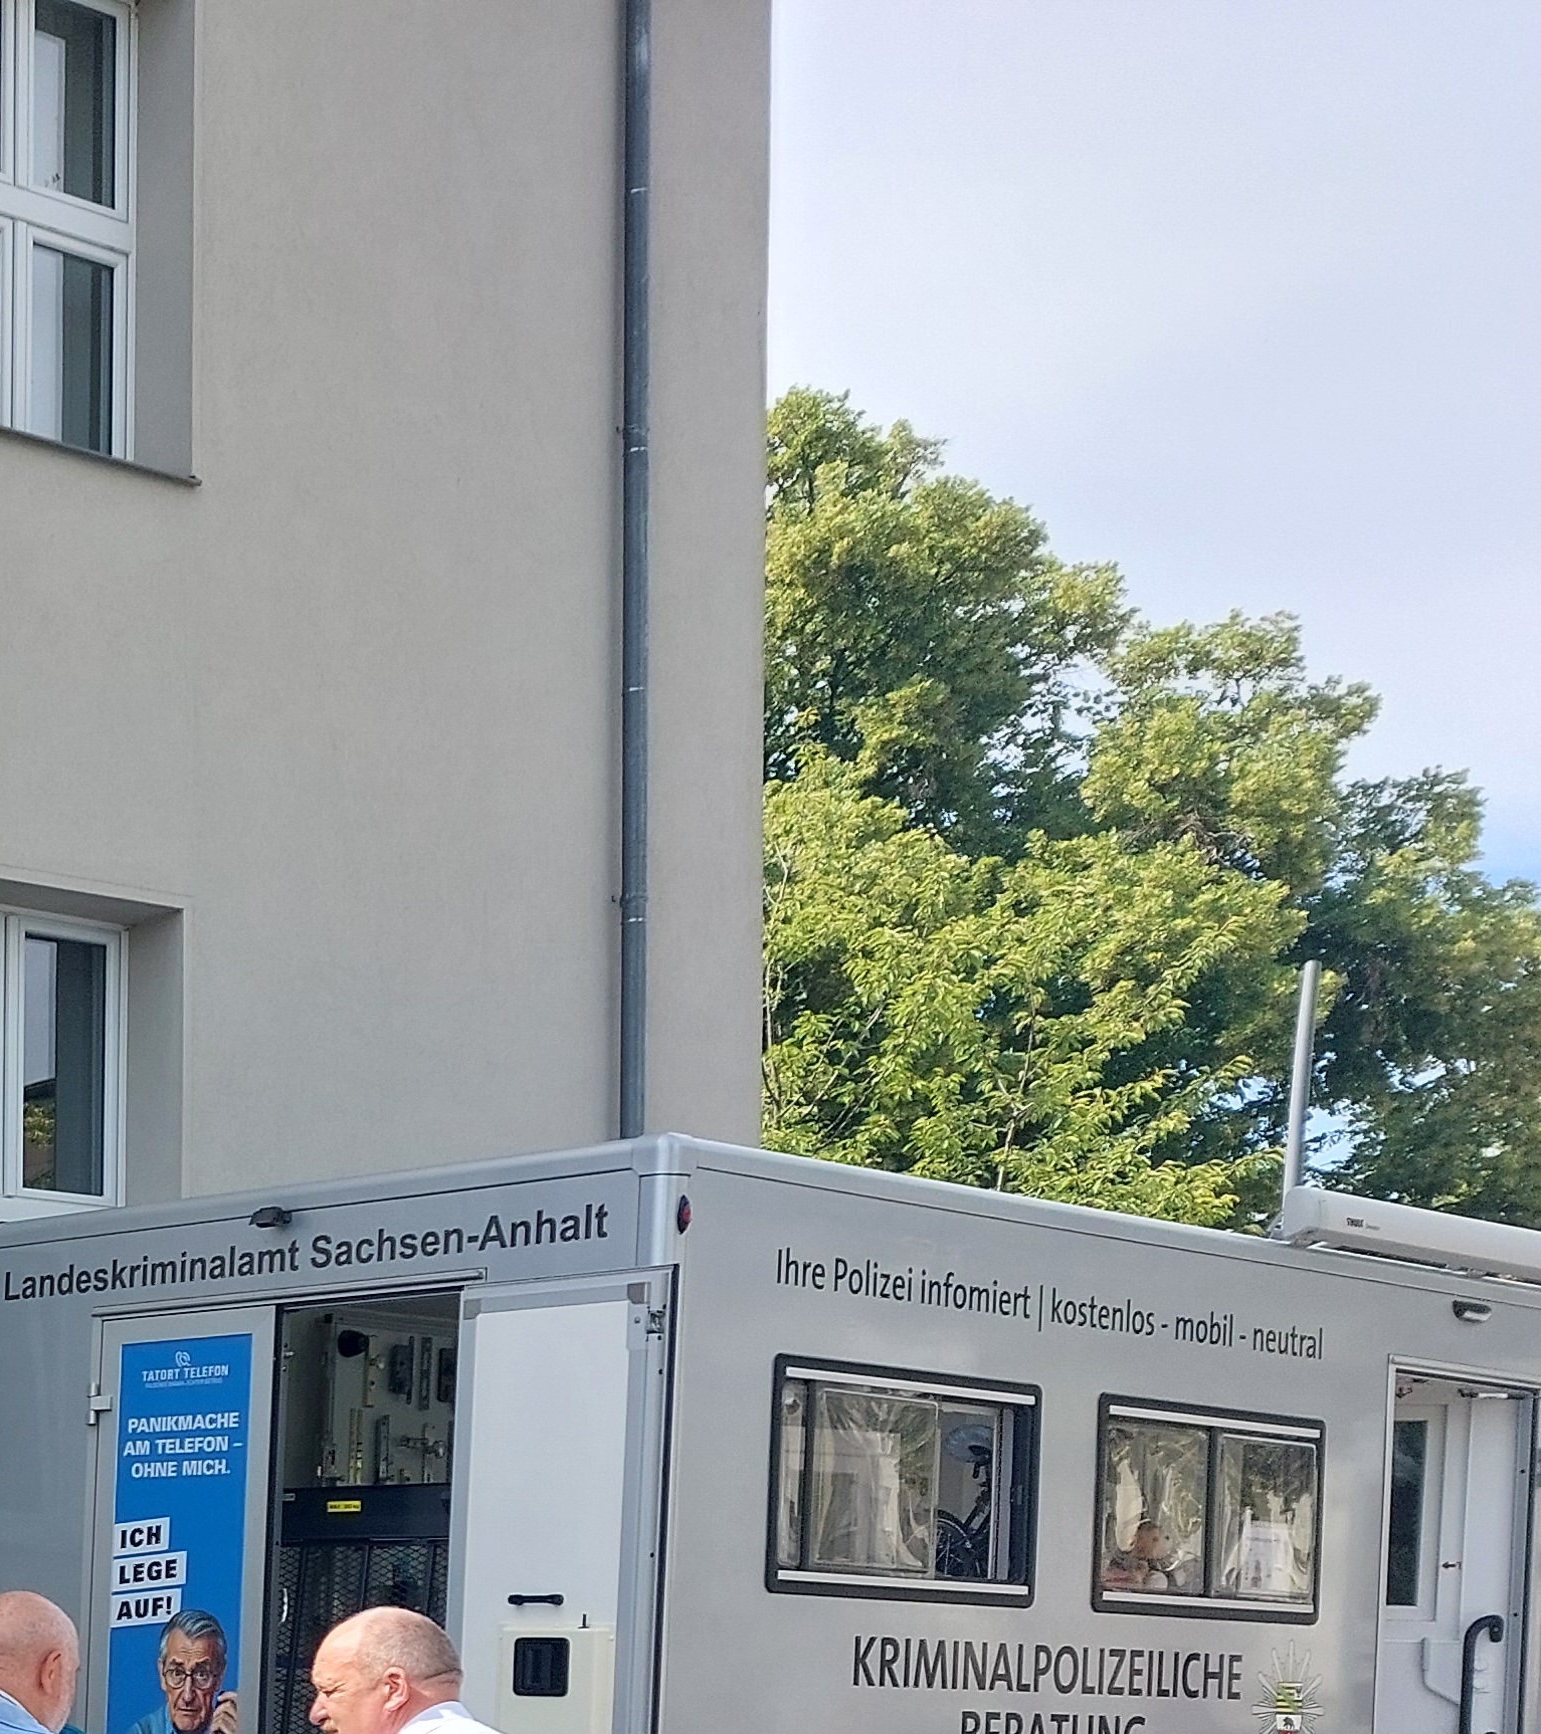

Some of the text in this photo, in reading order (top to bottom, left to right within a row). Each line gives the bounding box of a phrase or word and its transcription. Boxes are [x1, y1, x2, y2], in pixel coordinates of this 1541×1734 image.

[3, 1203, 610, 1301] Landeskriminalamt Sachsen-Anhalt
[775, 1248, 826, 1291] Ihre
[832, 1256, 914, 1303] Polizei
[920, 1268, 1032, 1319] infomiert
[1051, 1288, 1157, 1337] kostenlos
[1175, 1310, 1235, 1349] mobil
[1253, 1324, 1325, 1361] neutral
[141, 1363, 229, 1382] TATORT TELEFON
[127, 1411, 240, 1434] PANIKMACHE
[123, 1439, 151, 1458] AM
[155, 1435, 229, 1455] TELEFON
[131, 1458, 232, 1479] OHNE MICH.
[120, 1524, 163, 1549] ICH
[118, 1558, 178, 1585] LEGE
[116, 1595, 173, 1621] AUF!
[852, 1635, 1244, 1700] KRIMINALPOLIZEILICHE
